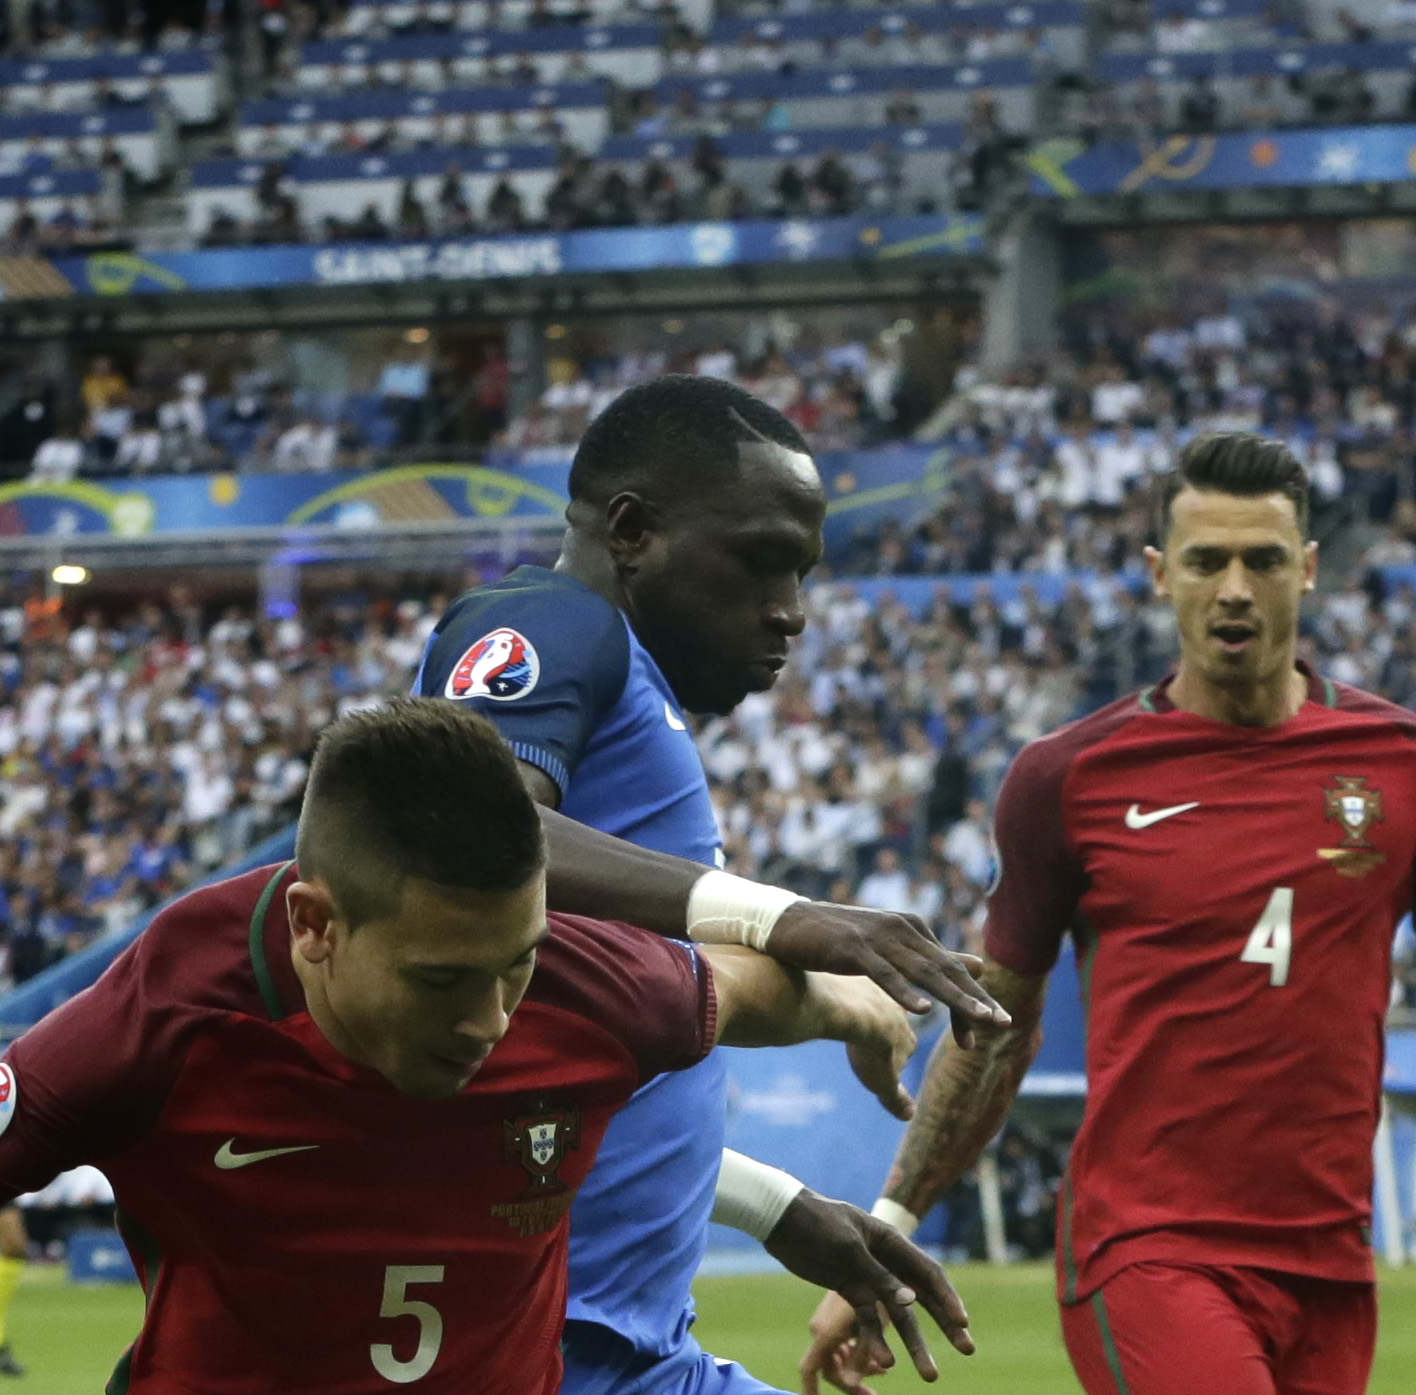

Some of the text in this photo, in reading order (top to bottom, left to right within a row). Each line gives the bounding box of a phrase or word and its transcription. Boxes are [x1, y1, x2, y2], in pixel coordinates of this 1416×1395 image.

[314, 239, 561, 285] SAINT-DENIS
[1240, 886, 1294, 987] 4
[370, 1265, 445, 1384] 5
